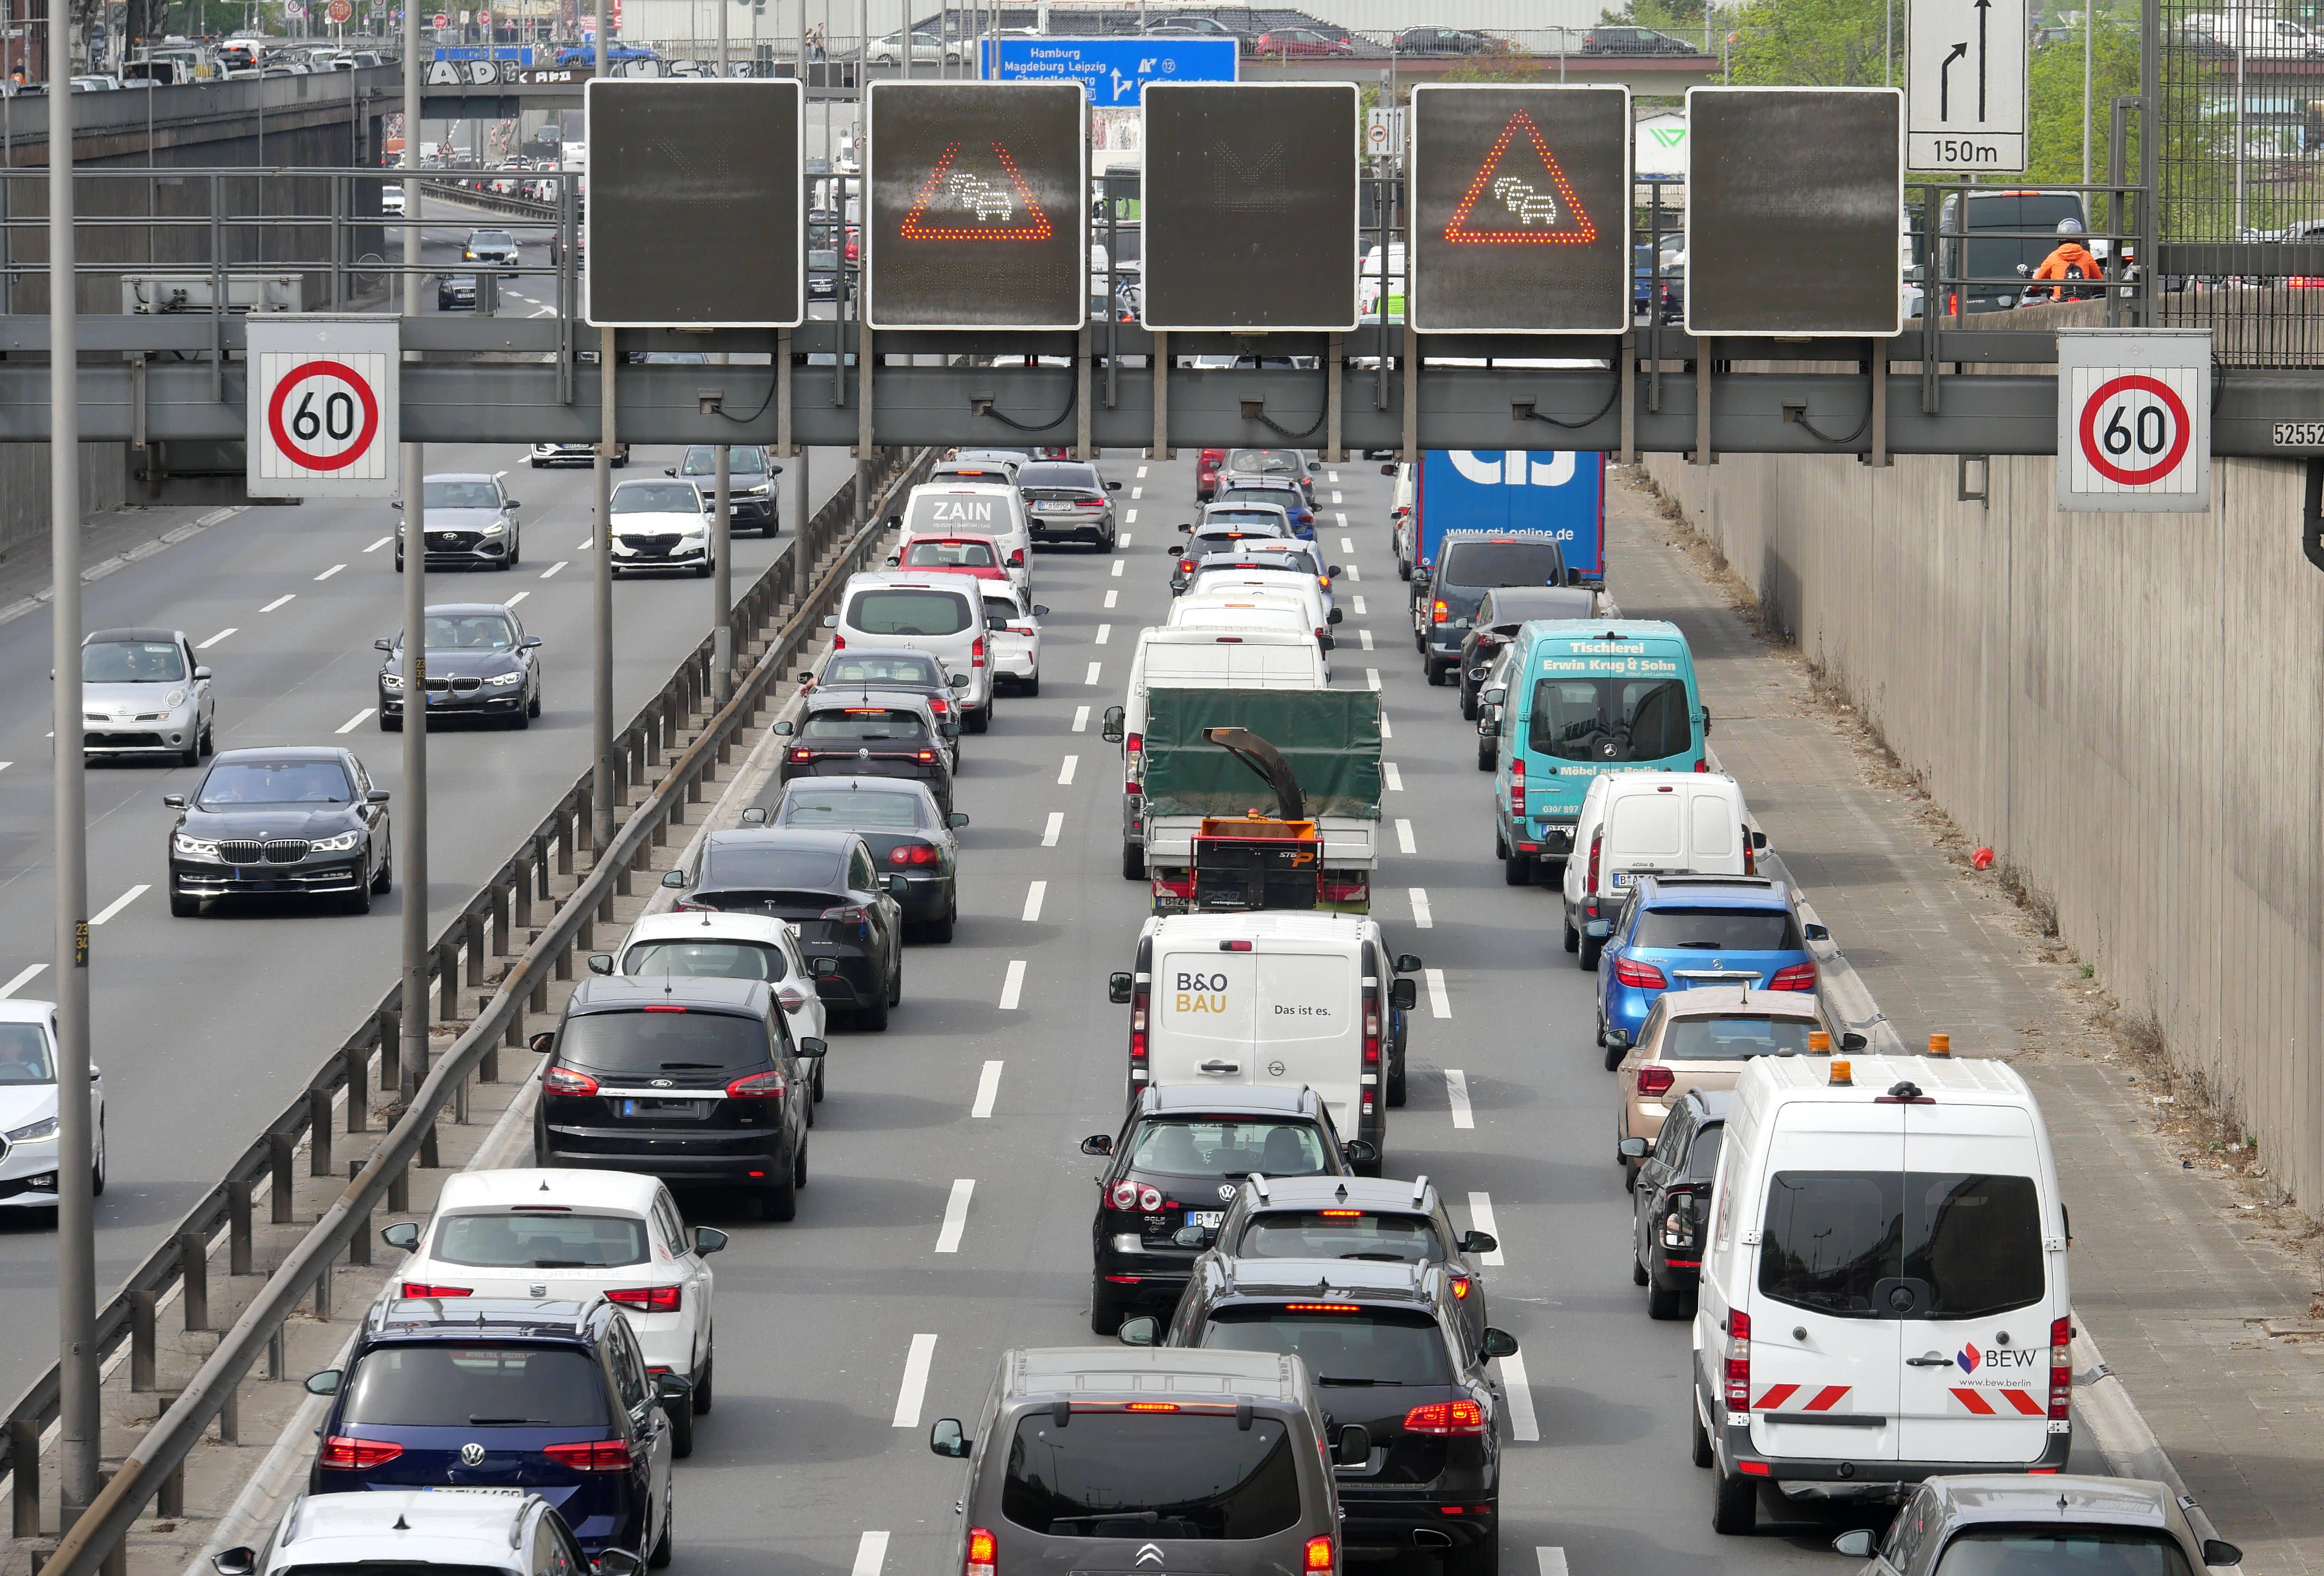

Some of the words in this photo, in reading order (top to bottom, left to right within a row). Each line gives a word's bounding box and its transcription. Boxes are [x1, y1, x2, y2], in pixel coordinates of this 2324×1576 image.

[331, 7, 349, 15] STOP
[1031, 48, 1080, 59] Hamburg
[1005, 62, 1063, 74] Magdeburg
[1069, 61, 1106, 73] Leipzig
[1935, 140, 1997, 162] 150m
[293, 392, 353, 440] 60
[2104, 406, 2165, 455] 60
[2275, 425, 2324, 444] 52552
[933, 502, 991, 520] ZAIN
[1570, 642, 1644, 653] Tischlerei
[417, 660, 425, 668] 23
[1543, 660, 1585, 670] Erwin
[1590, 660, 1624, 672] Krug
[1627, 657, 1637, 670] &
[1641, 660, 1676, 671] Sohn
[417, 670, 425, 678] 33
[1560, 766, 1596, 775] Möbel
[1621, 876, 1625, 884] B
[76, 924, 88, 935] 23
[76, 937, 88, 949] 34
[1177, 973, 1228, 992] B&O
[1176, 994, 1226, 1013] BAU
[1274, 1005, 1295, 1015] Das
[1299, 1005, 1312, 1015] ist
[1315, 1008, 1331, 1016] es.
[1196, 1214, 1203, 1226] B
[534, 1270, 563, 1278] ZUR
[568, 1270, 624, 1278] PFLEGE
[1986, 1350, 2037, 1367] BEW
[1959, 1379, 2031, 1387] www.bew.berlin
